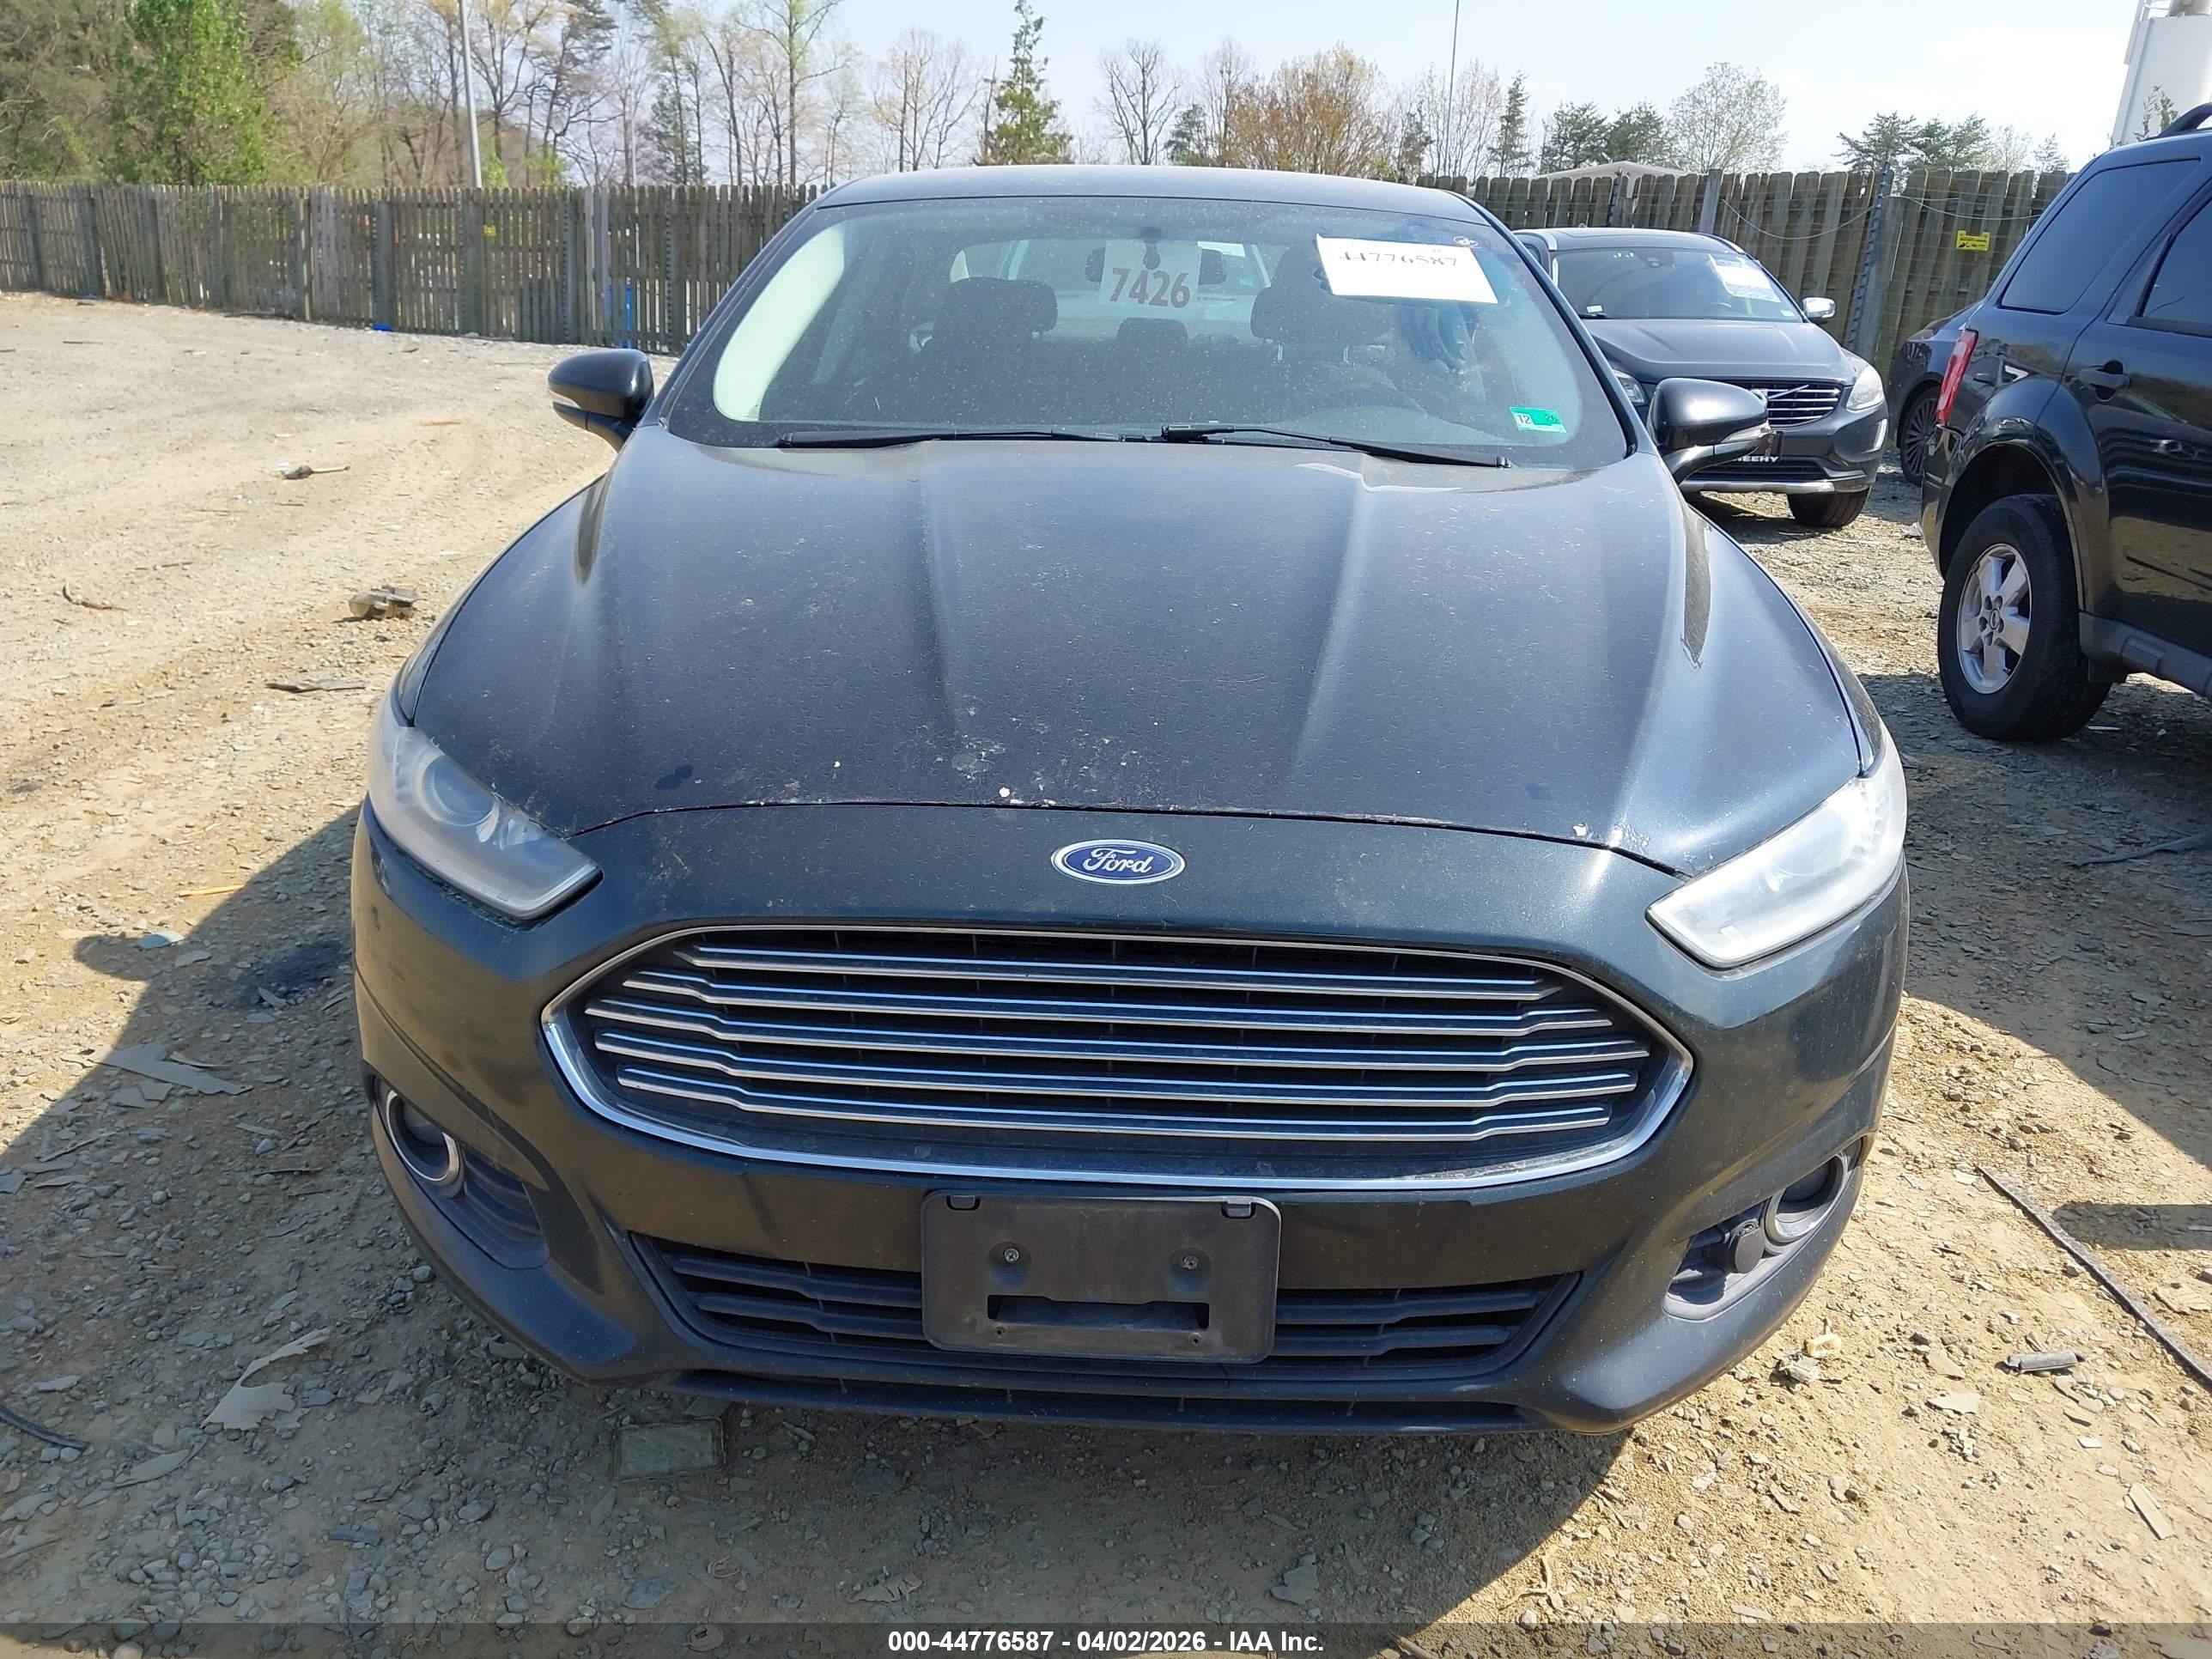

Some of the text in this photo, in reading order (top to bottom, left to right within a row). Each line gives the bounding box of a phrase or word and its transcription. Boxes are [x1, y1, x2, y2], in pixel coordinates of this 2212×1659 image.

[1109, 268, 1190, 308] 7426
[1516, 414, 1532, 424] 12
[1082, 848, 1154, 873] Ford
